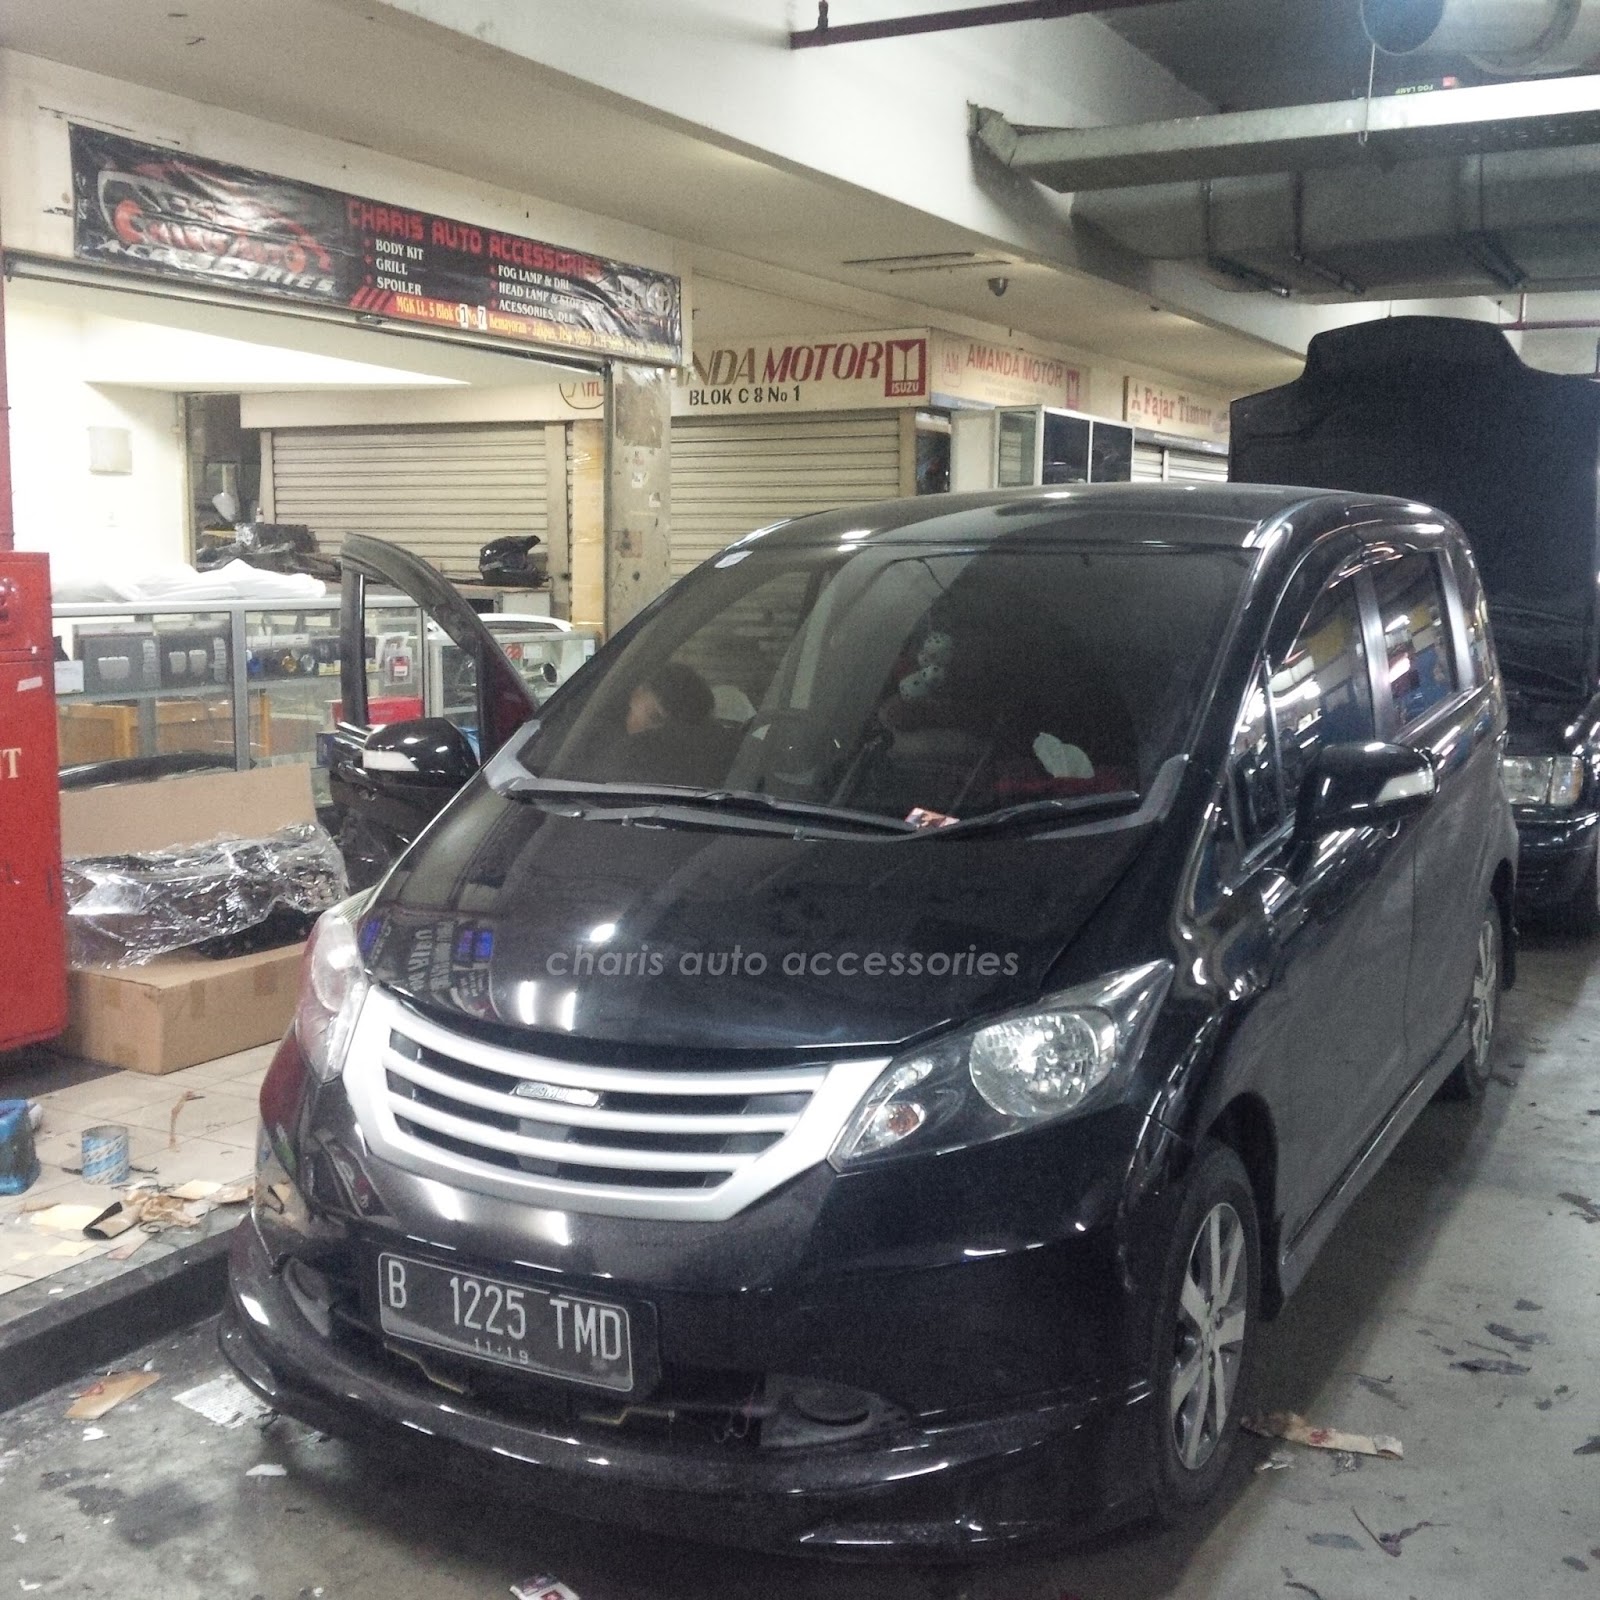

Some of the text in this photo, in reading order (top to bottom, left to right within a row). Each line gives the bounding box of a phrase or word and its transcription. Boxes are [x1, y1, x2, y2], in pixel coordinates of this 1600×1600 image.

[347, 200, 425, 241] CHARIS
[432, 220, 482, 254] AUTO
[376, 239, 424, 261] BODY KIT
[376, 258, 408, 276] GRILL
[498, 265, 517, 280] FOG
[519, 269, 542, 285] LAMP
[544, 275, 552, 287] &
[377, 276, 422, 296] SPOILER
[499, 281, 523, 297] HEAD
[525, 287, 549, 303] LAMP
[550, 294, 558, 305] &
[436, 303, 454, 321] Blok
[761, 341, 884, 384] MOTOR
[966, 344, 1020, 378] AMANDA
[1021, 356, 1063, 388] MOTOR
[689, 389, 732, 406] BLOK
[738, 388, 749, 403] C
[753, 386, 763, 402] 8
[793, 385, 800, 401] 1
[891, 383, 919, 394] ISUZU
[1144, 386, 1175, 424] Fajar
[388, 1260, 622, 1361] B 1225 TMD
